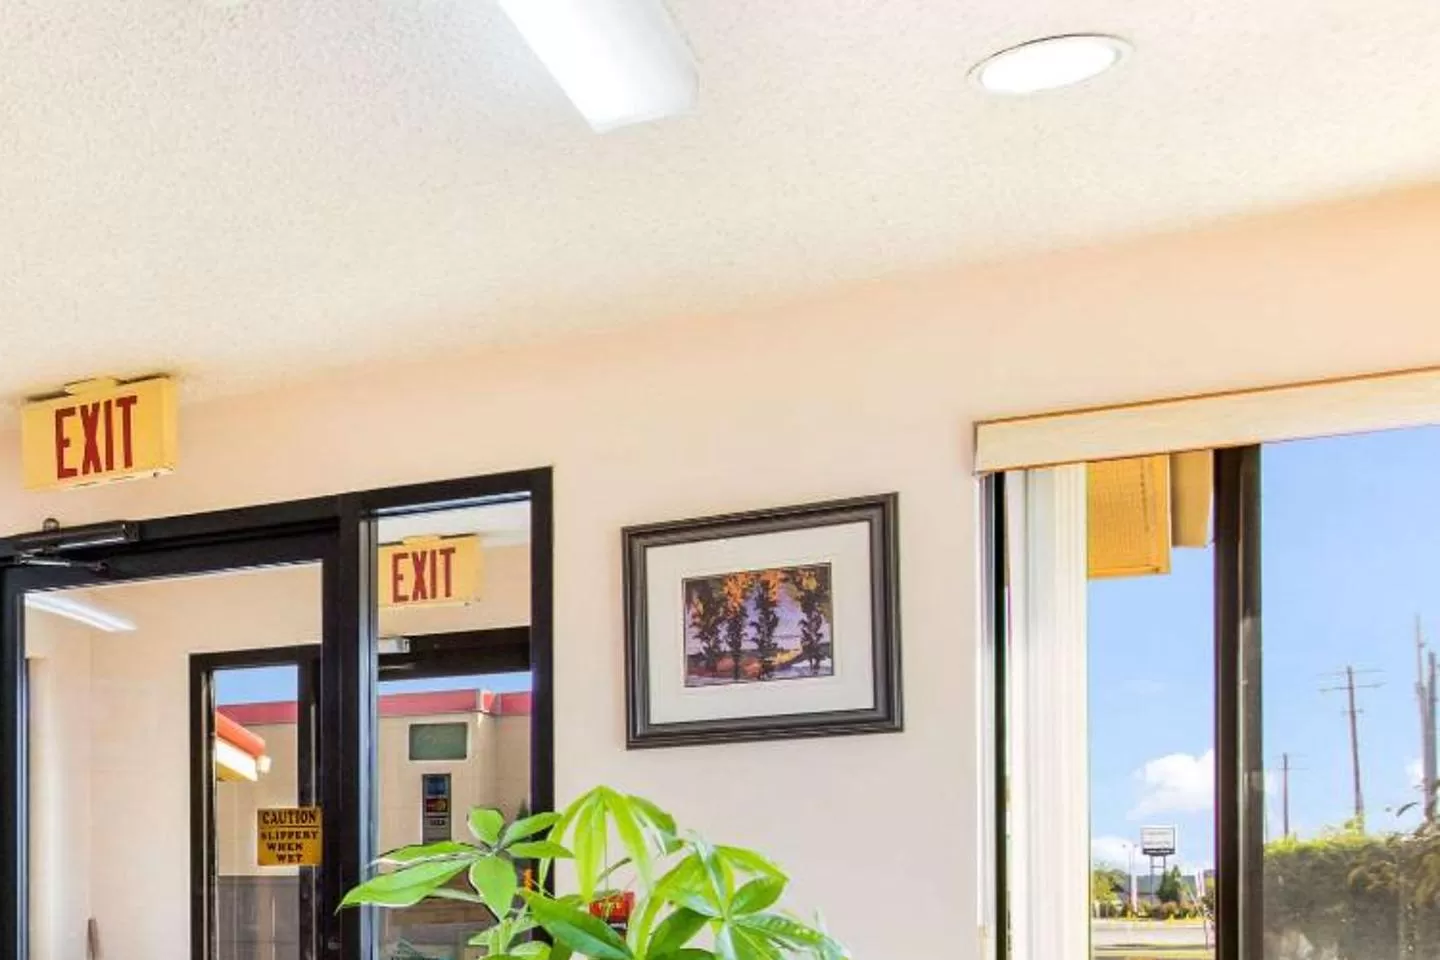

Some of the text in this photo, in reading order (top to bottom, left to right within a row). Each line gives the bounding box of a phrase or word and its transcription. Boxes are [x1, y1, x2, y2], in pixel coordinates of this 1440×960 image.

[55, 395, 137, 480] EXIT
[392, 547, 456, 603] EXIT
[262, 810, 316, 825] CAUTION
[266, 842, 303, 851] WHEN
[276, 854, 303, 863] WET
